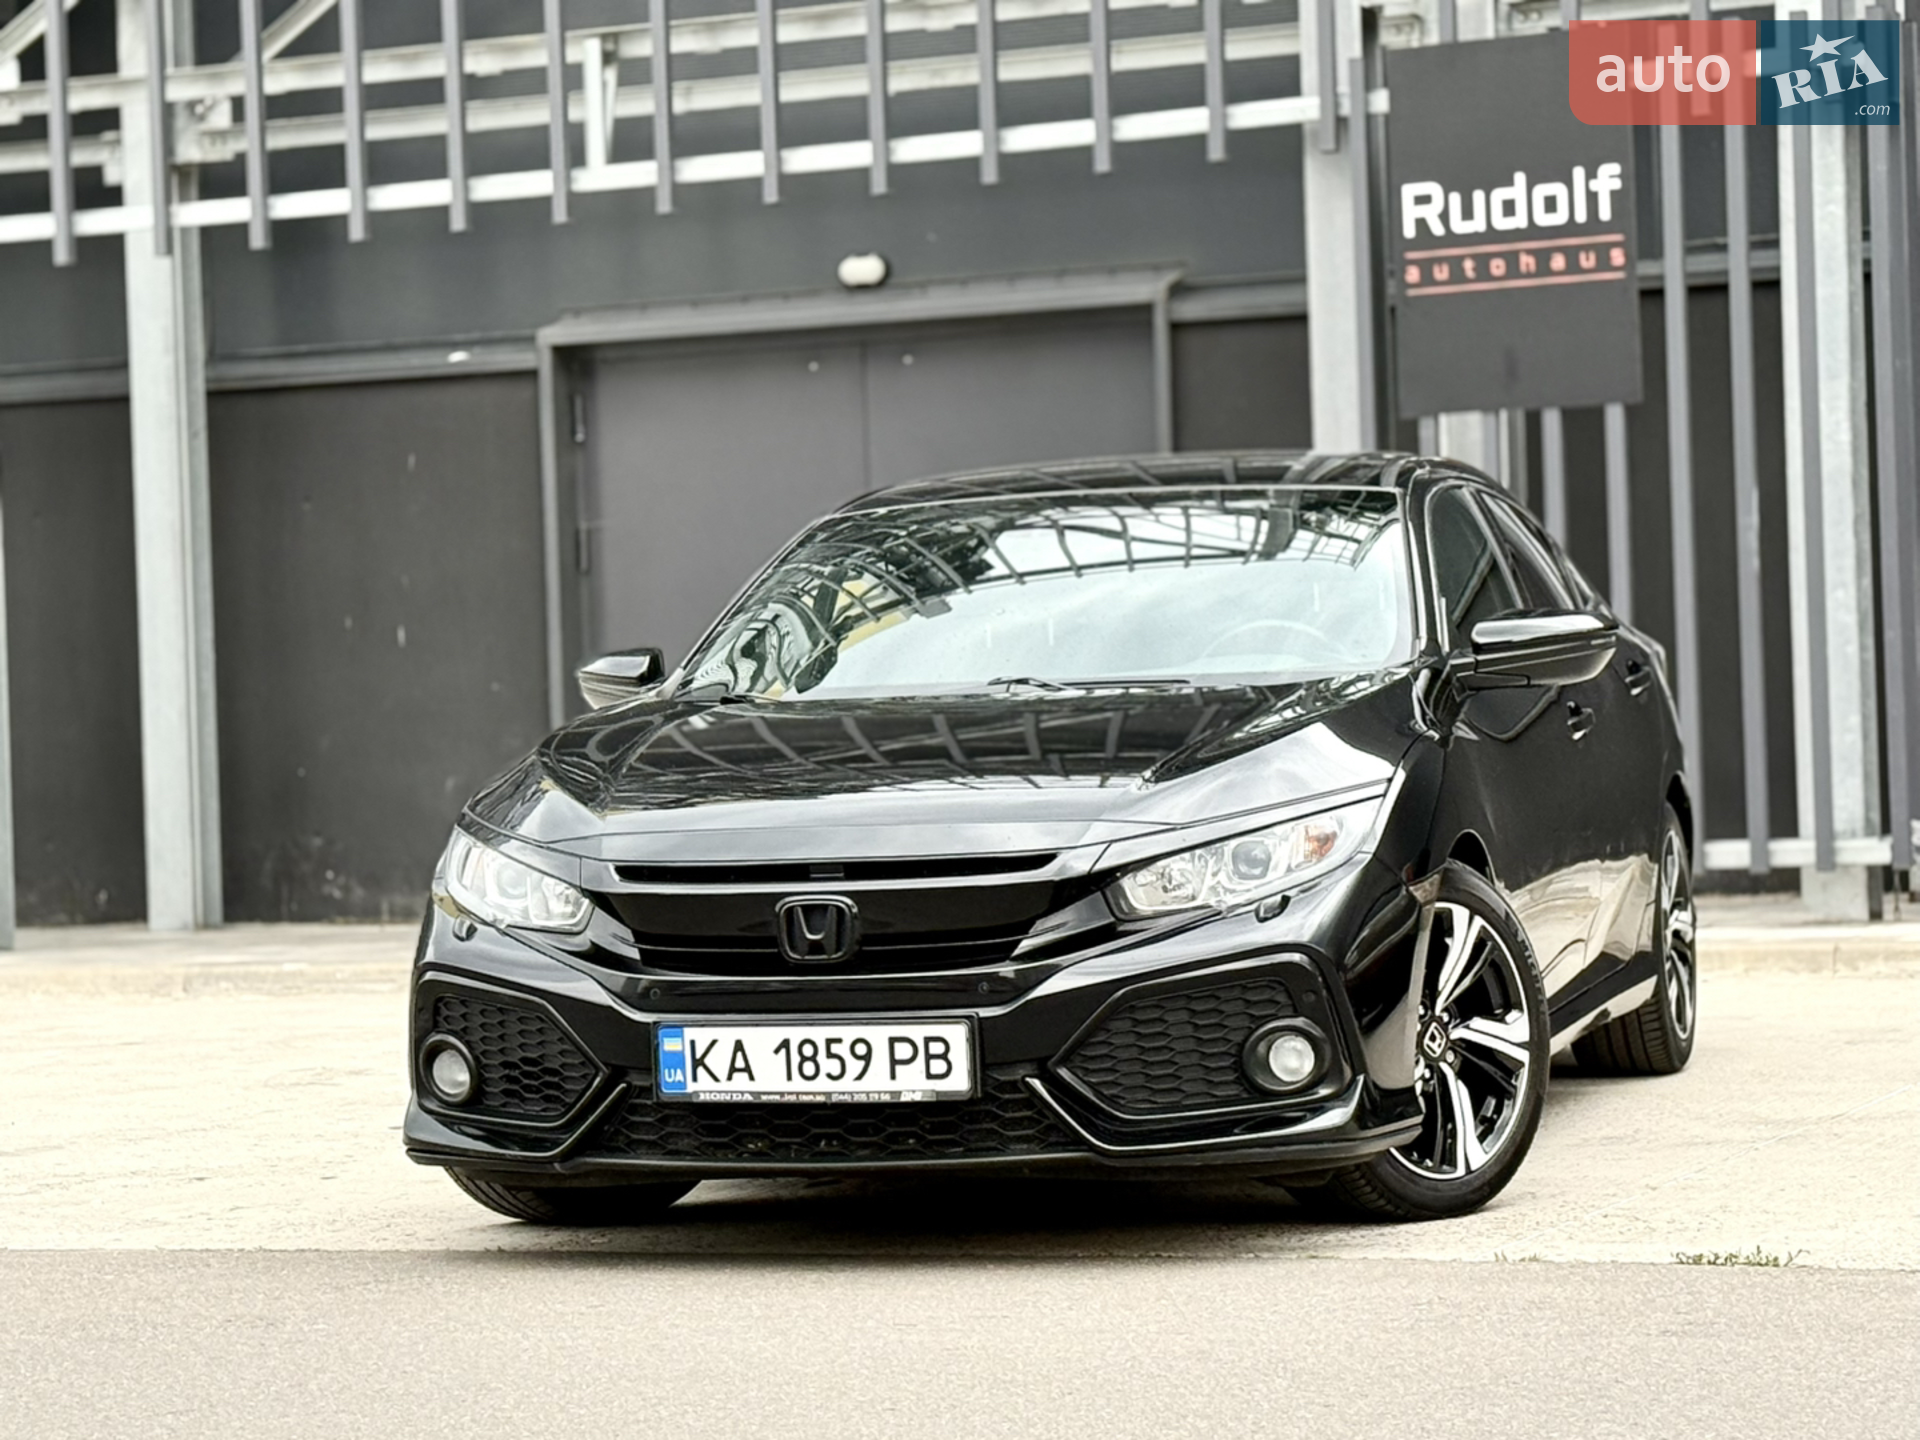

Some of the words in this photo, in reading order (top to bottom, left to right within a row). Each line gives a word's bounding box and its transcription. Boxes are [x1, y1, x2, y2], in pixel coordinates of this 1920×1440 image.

[1400, 162, 1623, 240] Rudolf
[1403, 247, 1627, 285] autohaus
[664, 1068, 684, 1083] UA
[689, 1038, 756, 1083] KA
[773, 1037, 873, 1082] 1859
[887, 1035, 953, 1081] PB
[699, 1092, 754, 1101] HONDA
